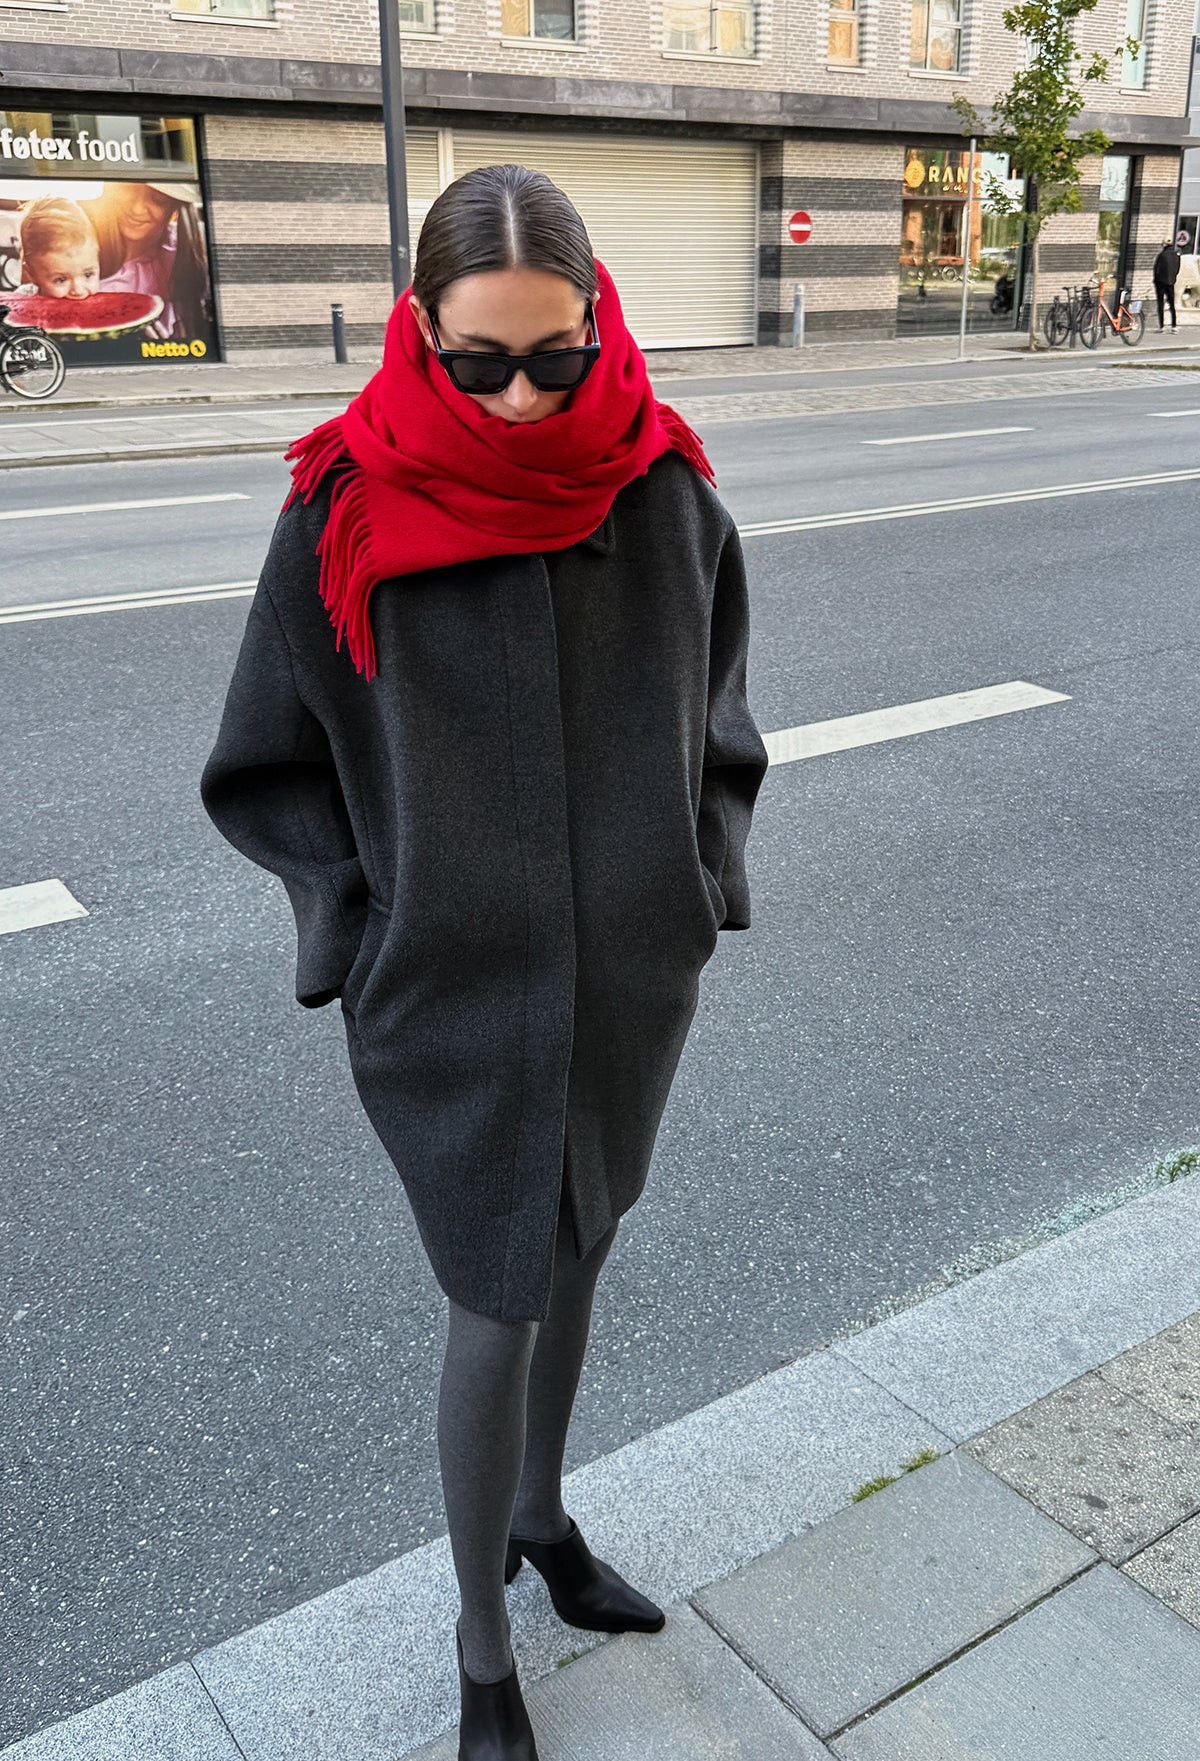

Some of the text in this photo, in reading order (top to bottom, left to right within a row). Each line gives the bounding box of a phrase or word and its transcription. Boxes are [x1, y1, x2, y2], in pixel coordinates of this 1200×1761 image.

[0, 128, 139, 162] føtex food
[141, 341, 189, 357] Netto
